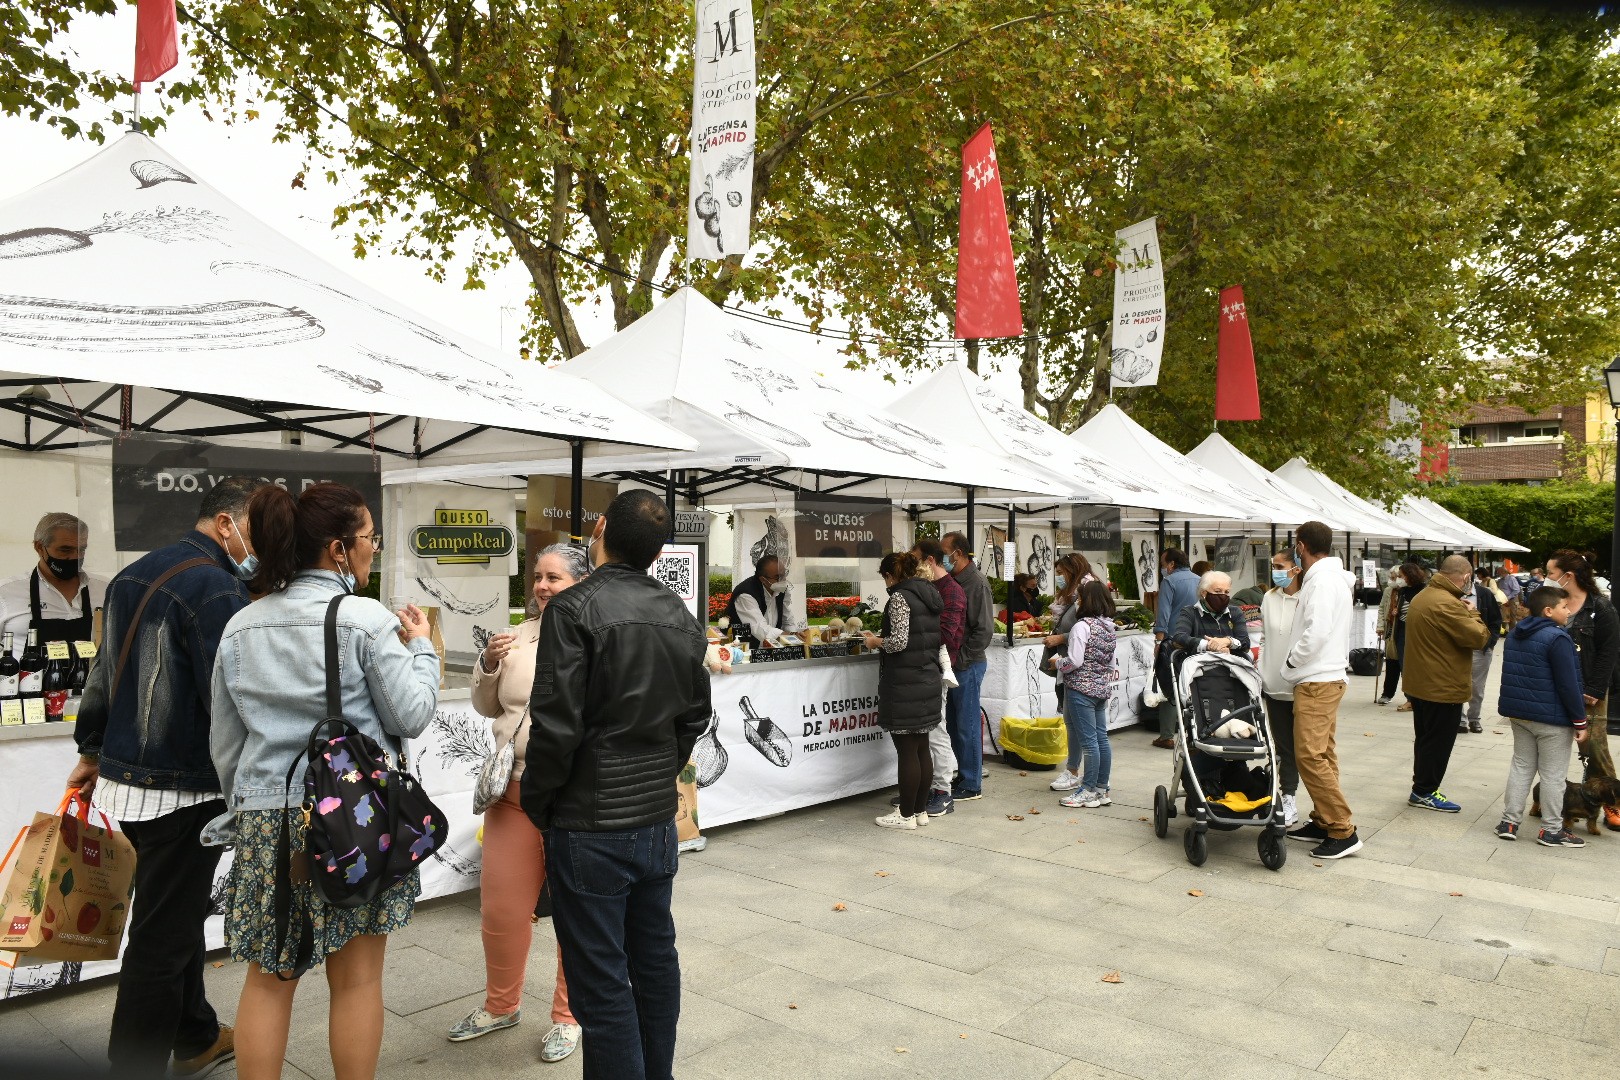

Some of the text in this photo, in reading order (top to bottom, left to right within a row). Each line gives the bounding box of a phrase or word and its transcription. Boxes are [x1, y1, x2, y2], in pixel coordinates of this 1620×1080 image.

[707, 8, 743, 63] M
[1131, 243, 1153, 274] M
[1123, 284, 1162, 297] PRODUCTO
[1122, 292, 1162, 303] CERTIFICADO
[1132, 308, 1162, 318] DESPENSA
[1133, 315, 1162, 324] MADRID
[156, 472, 204, 492] D.O.
[440, 512, 483, 524] QUESO
[543, 507, 563, 519] esto
[822, 514, 865, 526] QUESOS
[1085, 519, 1106, 529] HUERTA
[675, 521, 705, 533] DRID
[815, 529, 874, 542] DE MADRID
[1080, 530, 1111, 540] DE MADRID
[415, 531, 506, 553] CampoReal
[802, 695, 879, 718] LA DESPENSA
[802, 711, 879, 737] DE MADRID
[803, 731, 884, 753] MERCADO ITINERANTE
